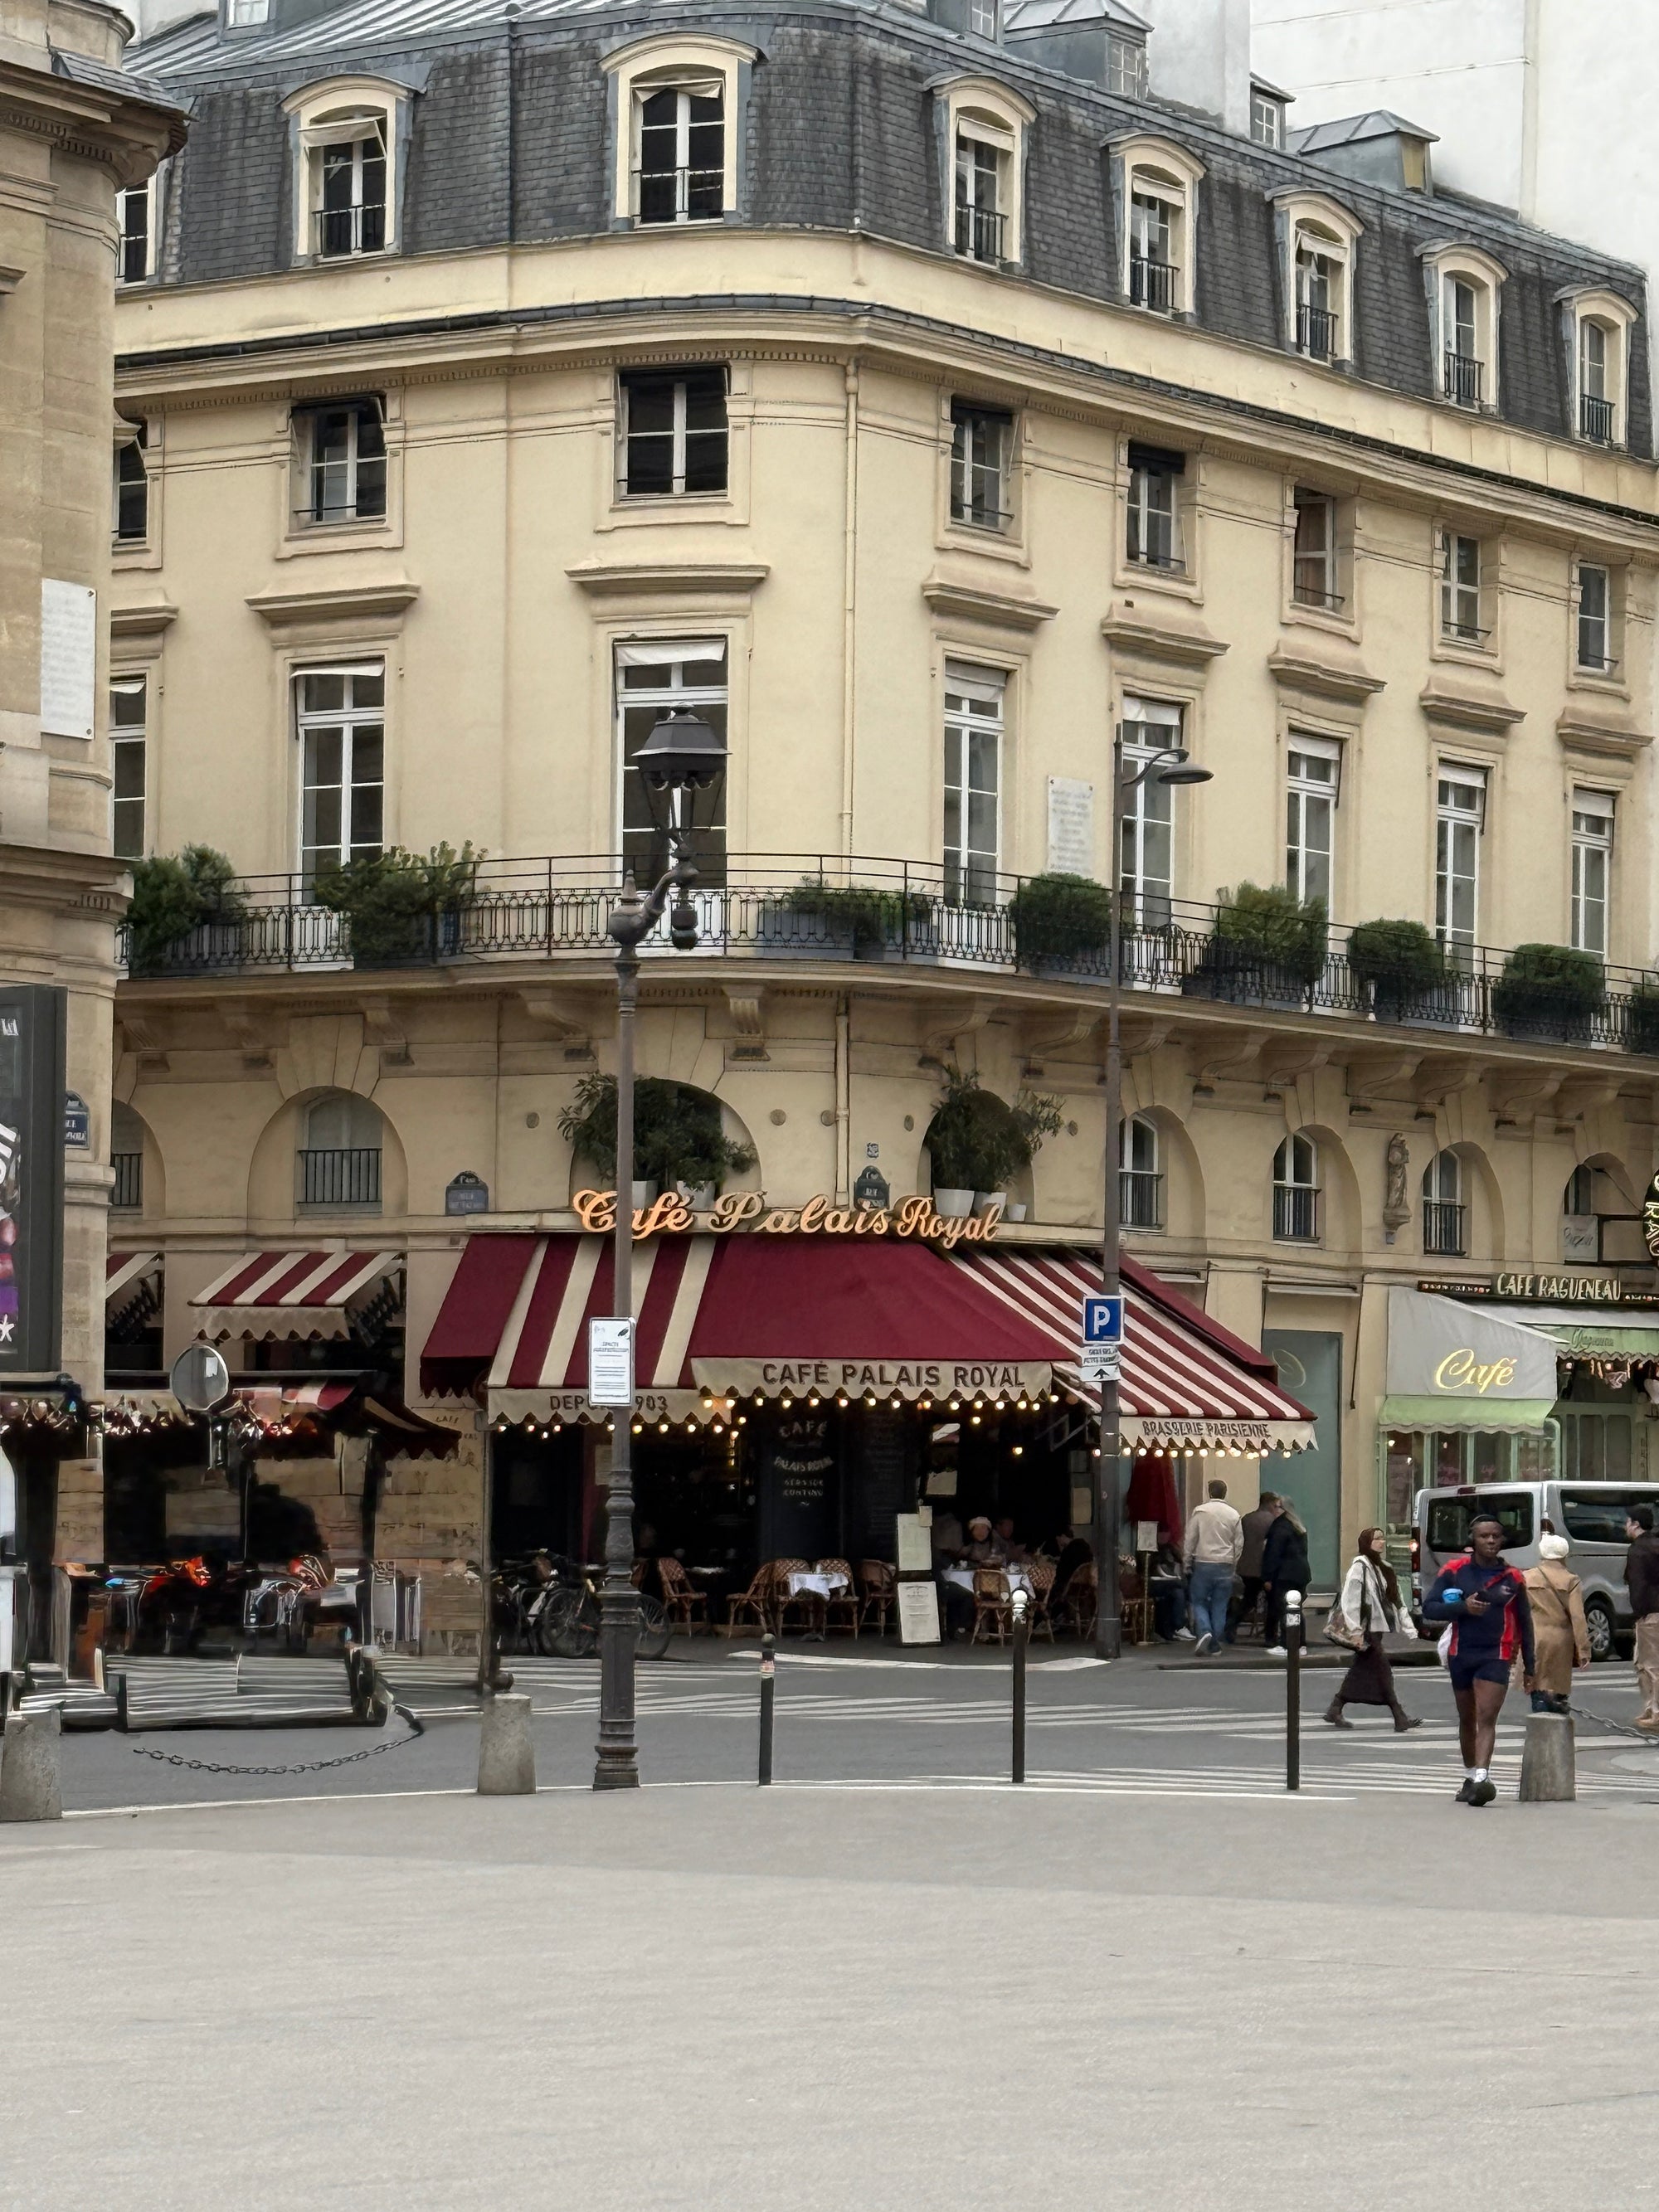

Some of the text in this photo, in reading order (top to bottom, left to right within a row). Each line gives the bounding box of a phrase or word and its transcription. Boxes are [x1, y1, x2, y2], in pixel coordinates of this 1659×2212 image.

[708, 1191, 890, 1235] Palais
[897, 1195, 1003, 1249] Royal
[1538, 1275, 1622, 1301] RAGUENEAU
[1093, 1305, 1111, 1335] P
[842, 1364, 941, 1388] PALAIS
[953, 1365, 1026, 1388] ROYAL
[1436, 1349, 1518, 1393] Café
[1142, 1420, 1272, 1438] BRASSERIE PARISIENNE
